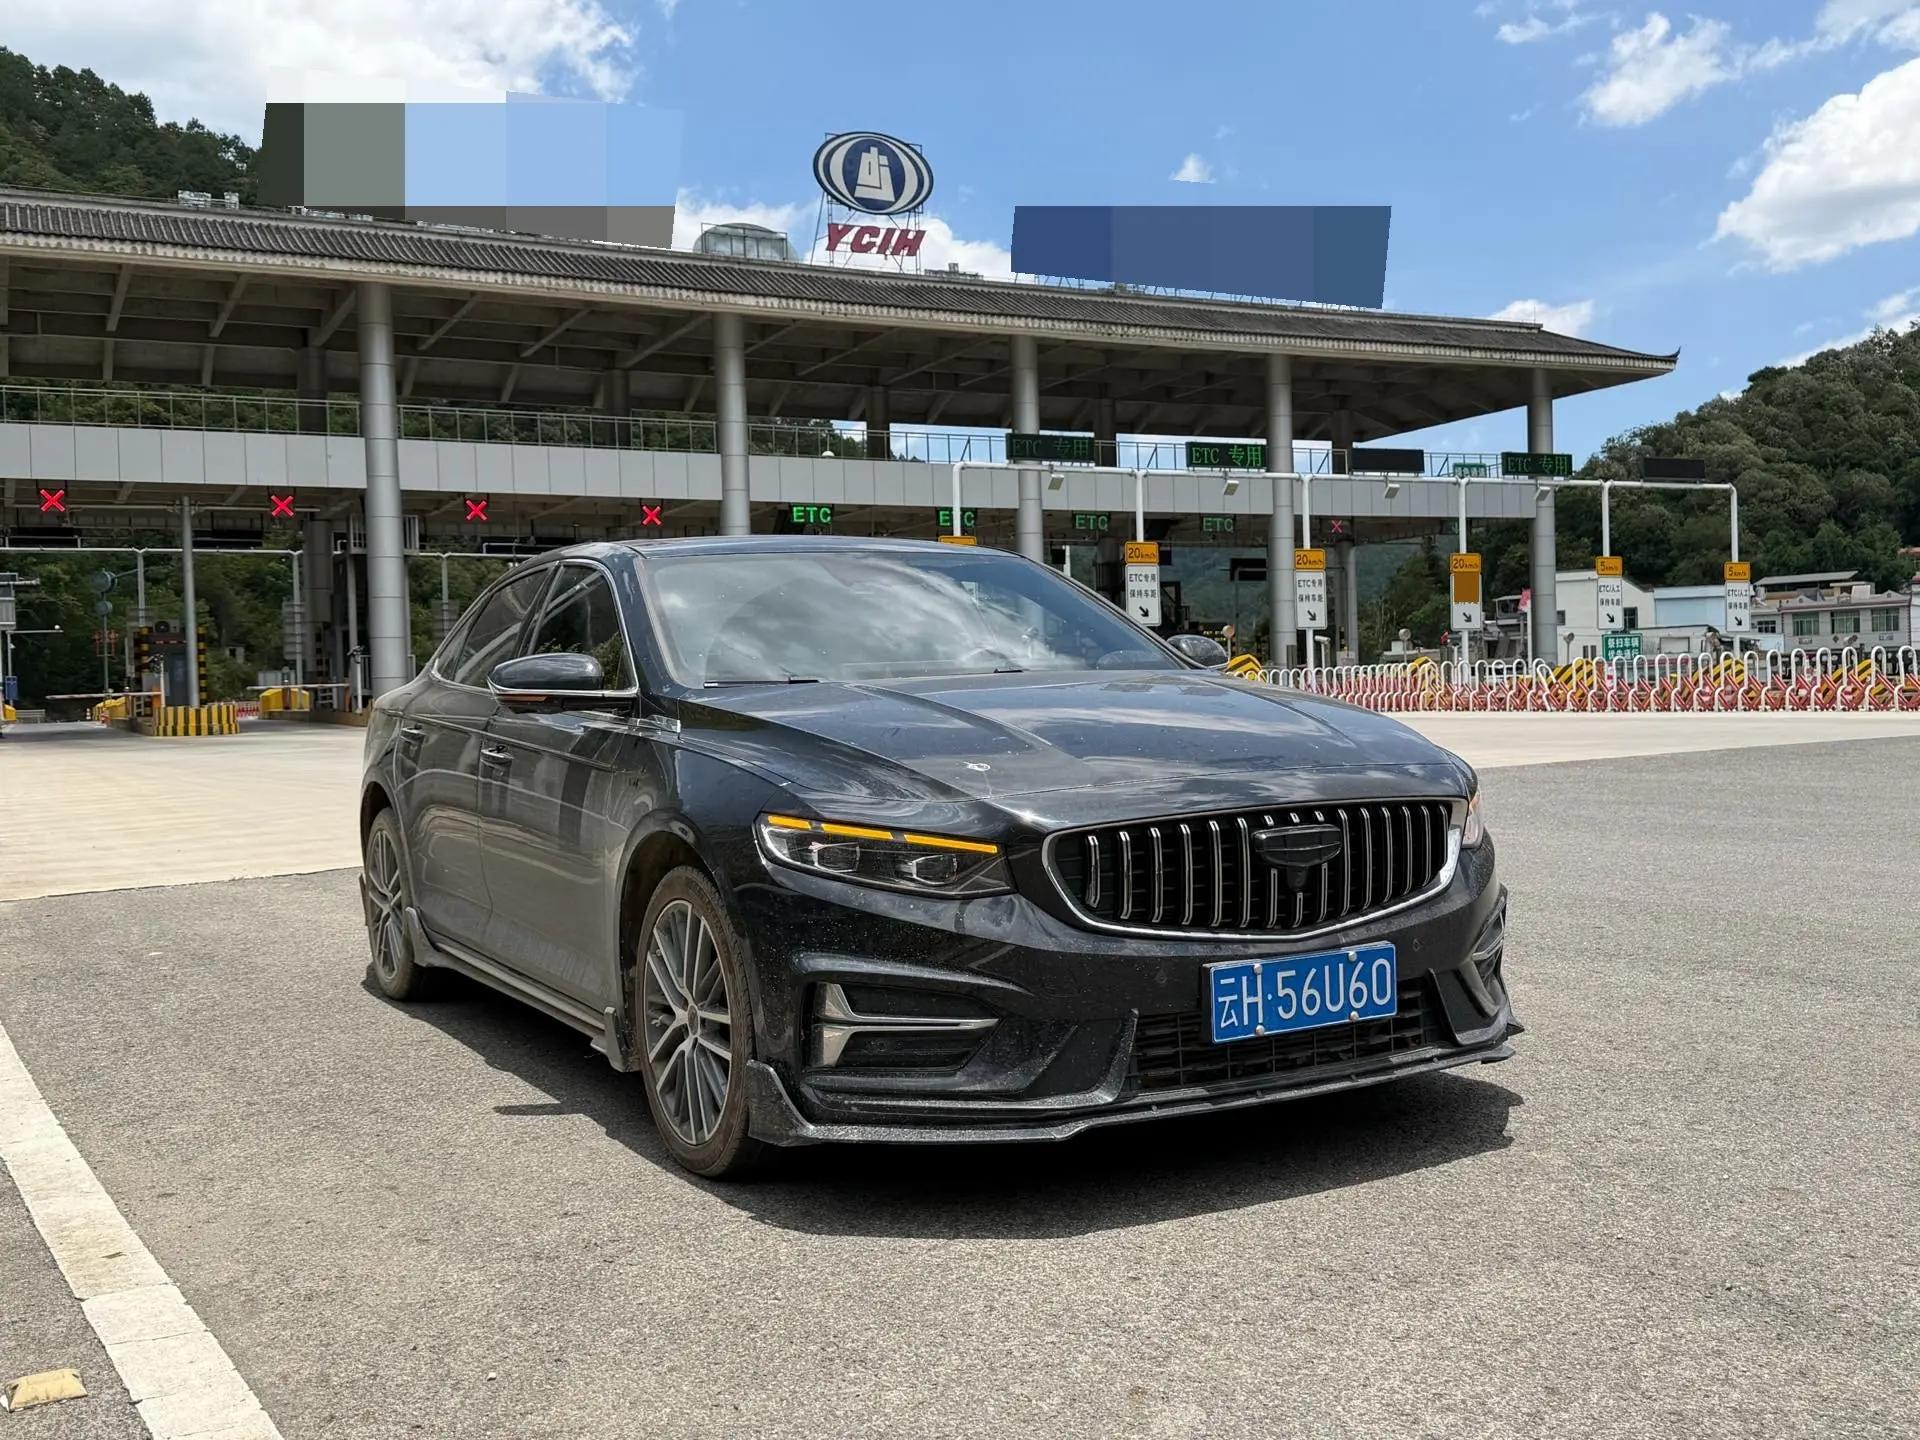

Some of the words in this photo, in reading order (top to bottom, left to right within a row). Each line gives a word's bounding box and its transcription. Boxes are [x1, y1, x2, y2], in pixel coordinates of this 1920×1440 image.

[826, 223, 927, 257] YCIH
[1012, 438, 1042, 457] ETC
[1052, 437, 1090, 459] 专用
[1191, 447, 1220, 464] ETC
[1228, 445, 1262, 467] 专用
[1507, 456, 1532, 473] ETC
[1540, 455, 1569, 475] 专用
[793, 506, 832, 523] ETC
[939, 510, 976, 528] EC
[1075, 514, 1108, 530] ETC
[1202, 516, 1234, 532] ETC
[1129, 589, 1157, 599] 保持车距
